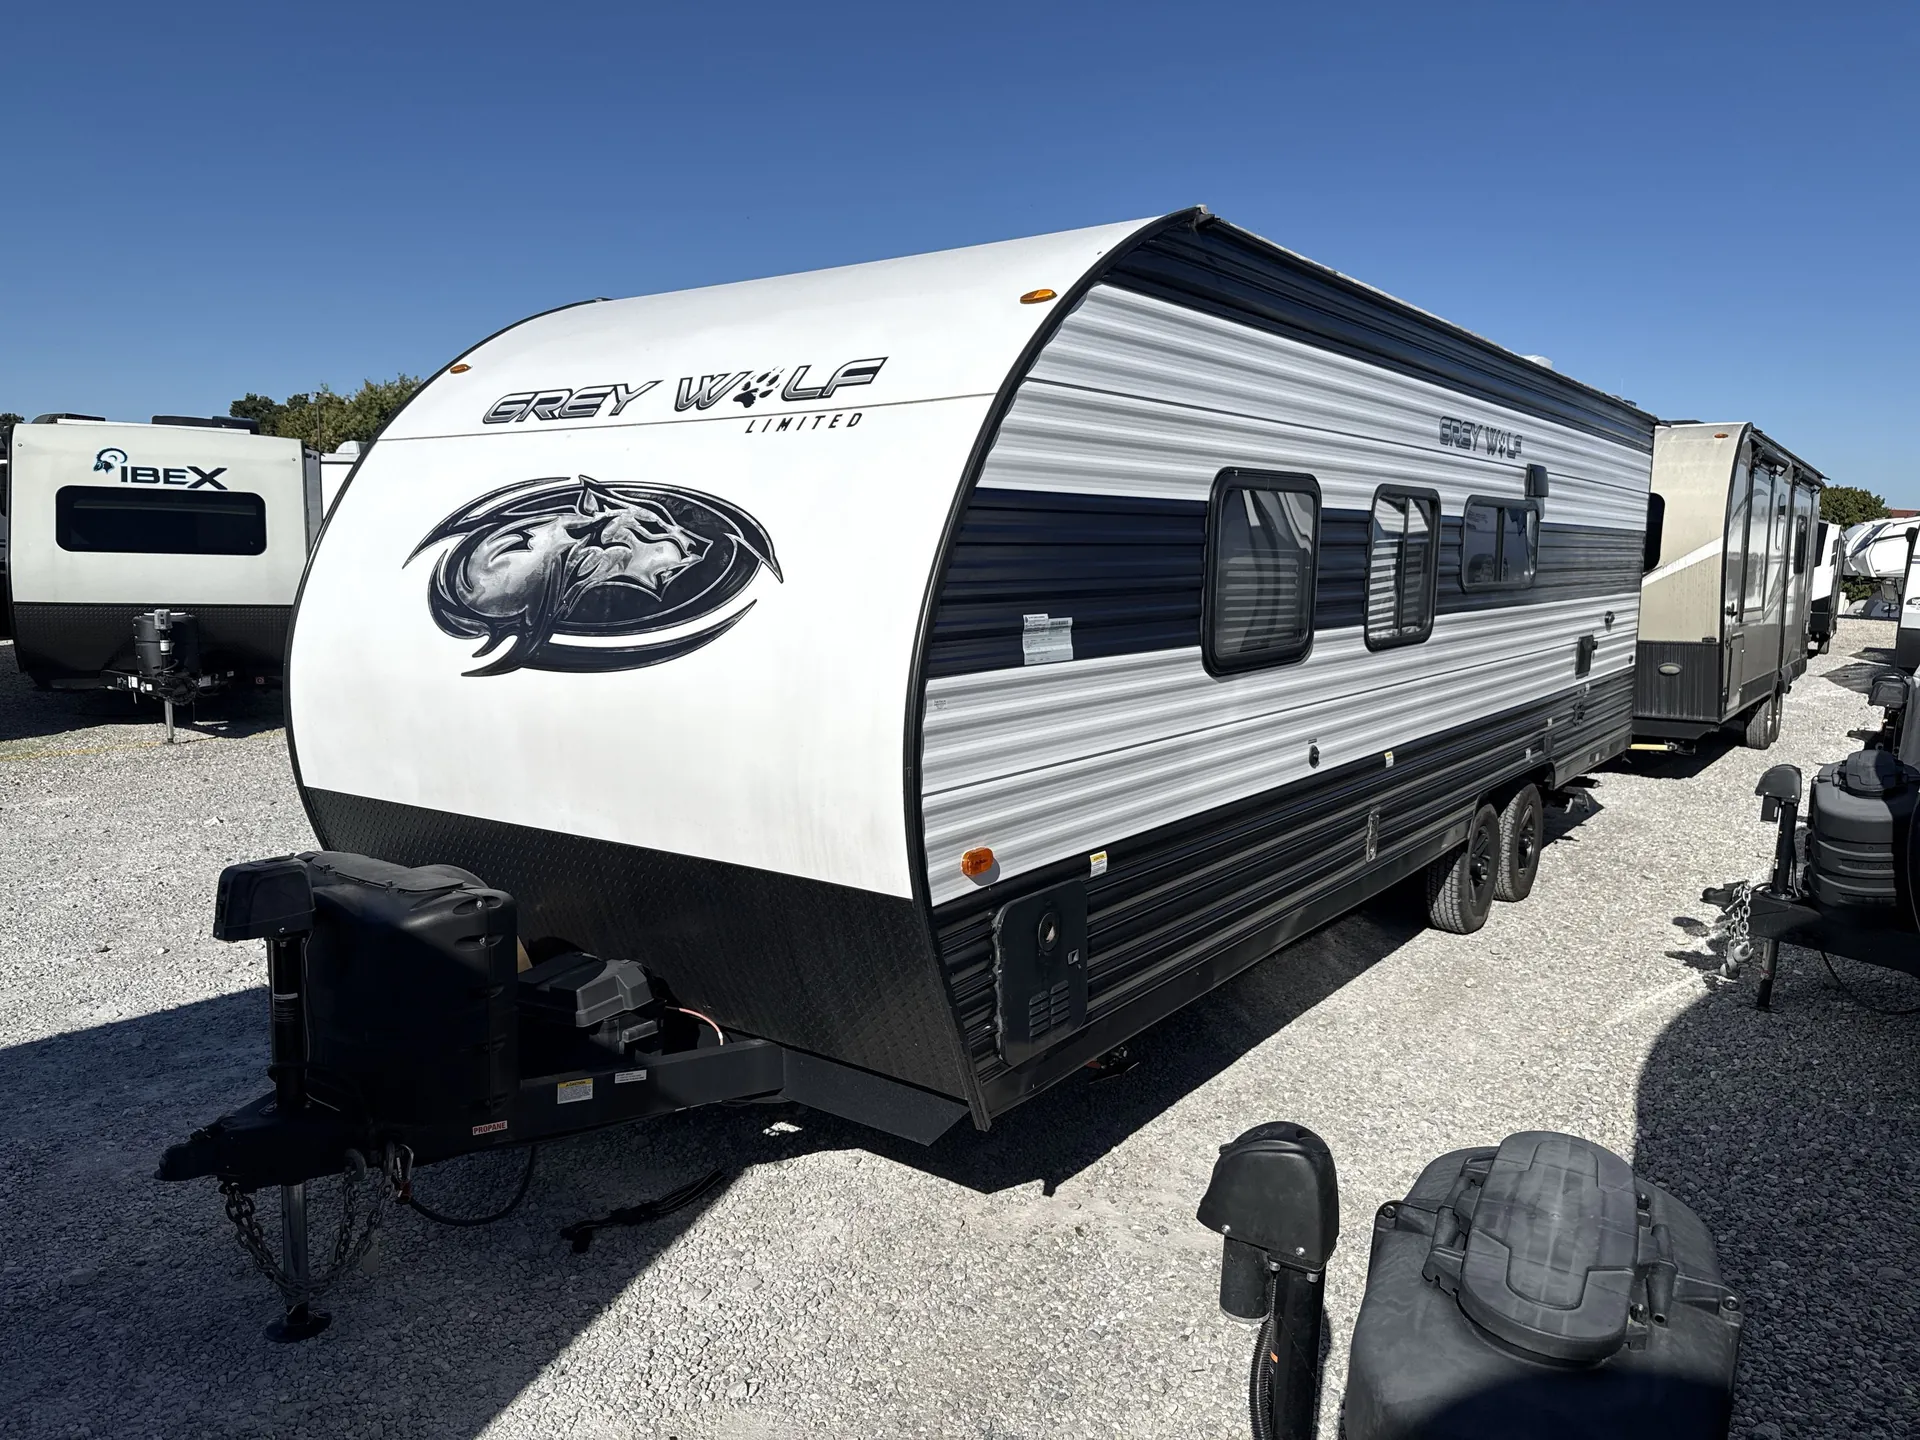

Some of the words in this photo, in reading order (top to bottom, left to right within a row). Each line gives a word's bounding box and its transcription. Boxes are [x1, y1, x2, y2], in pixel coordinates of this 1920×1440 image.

[482, 379, 664, 424] GREY
[674, 356, 889, 412] WOLF
[745, 412, 863, 434] LIMITED
[1440, 416, 1483, 451] GREY
[120, 465, 228, 490] IBEX
[473, 1121, 506, 1134] PROPANE
